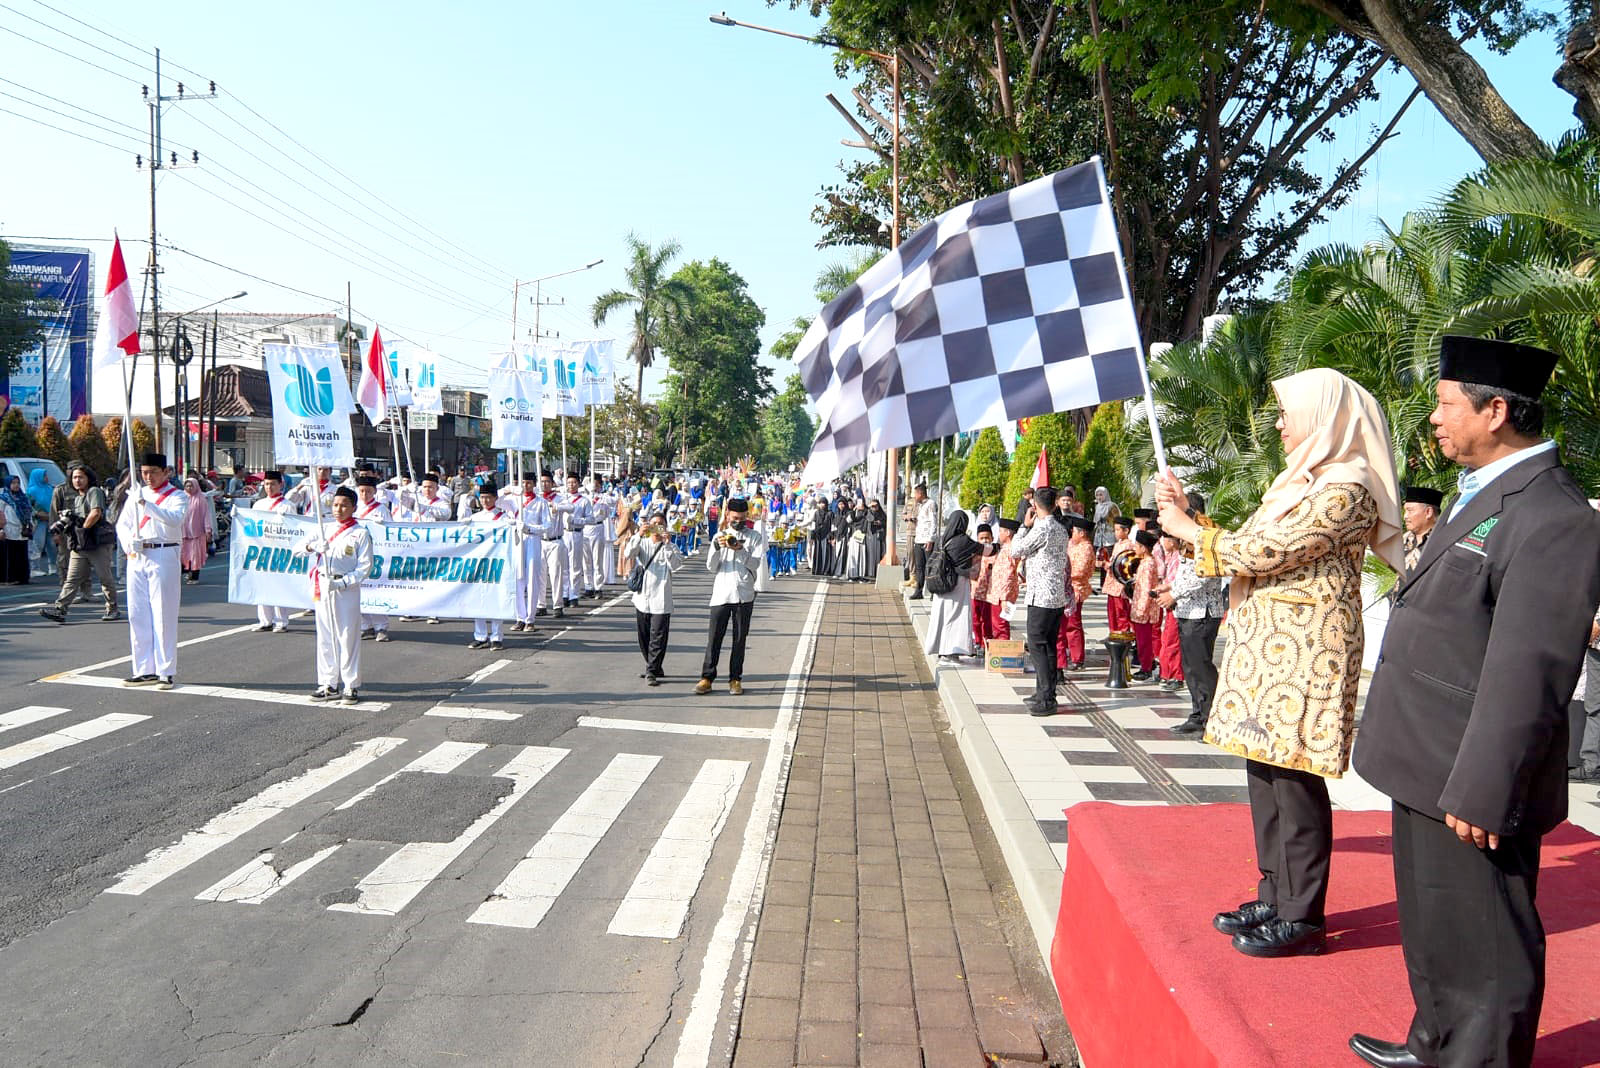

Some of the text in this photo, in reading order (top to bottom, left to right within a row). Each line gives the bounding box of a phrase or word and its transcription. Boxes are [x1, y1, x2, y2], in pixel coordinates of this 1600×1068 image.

[288, 429, 340, 441] Al-Uswah
[294, 440, 333, 449] Banyuwangi
[264, 526, 305, 536] Al-Uswah
[385, 526, 507, 544] FEST 1445 H
[243, 545, 309, 575] PAWAI
[388, 555, 505, 584] RAMADHAN
